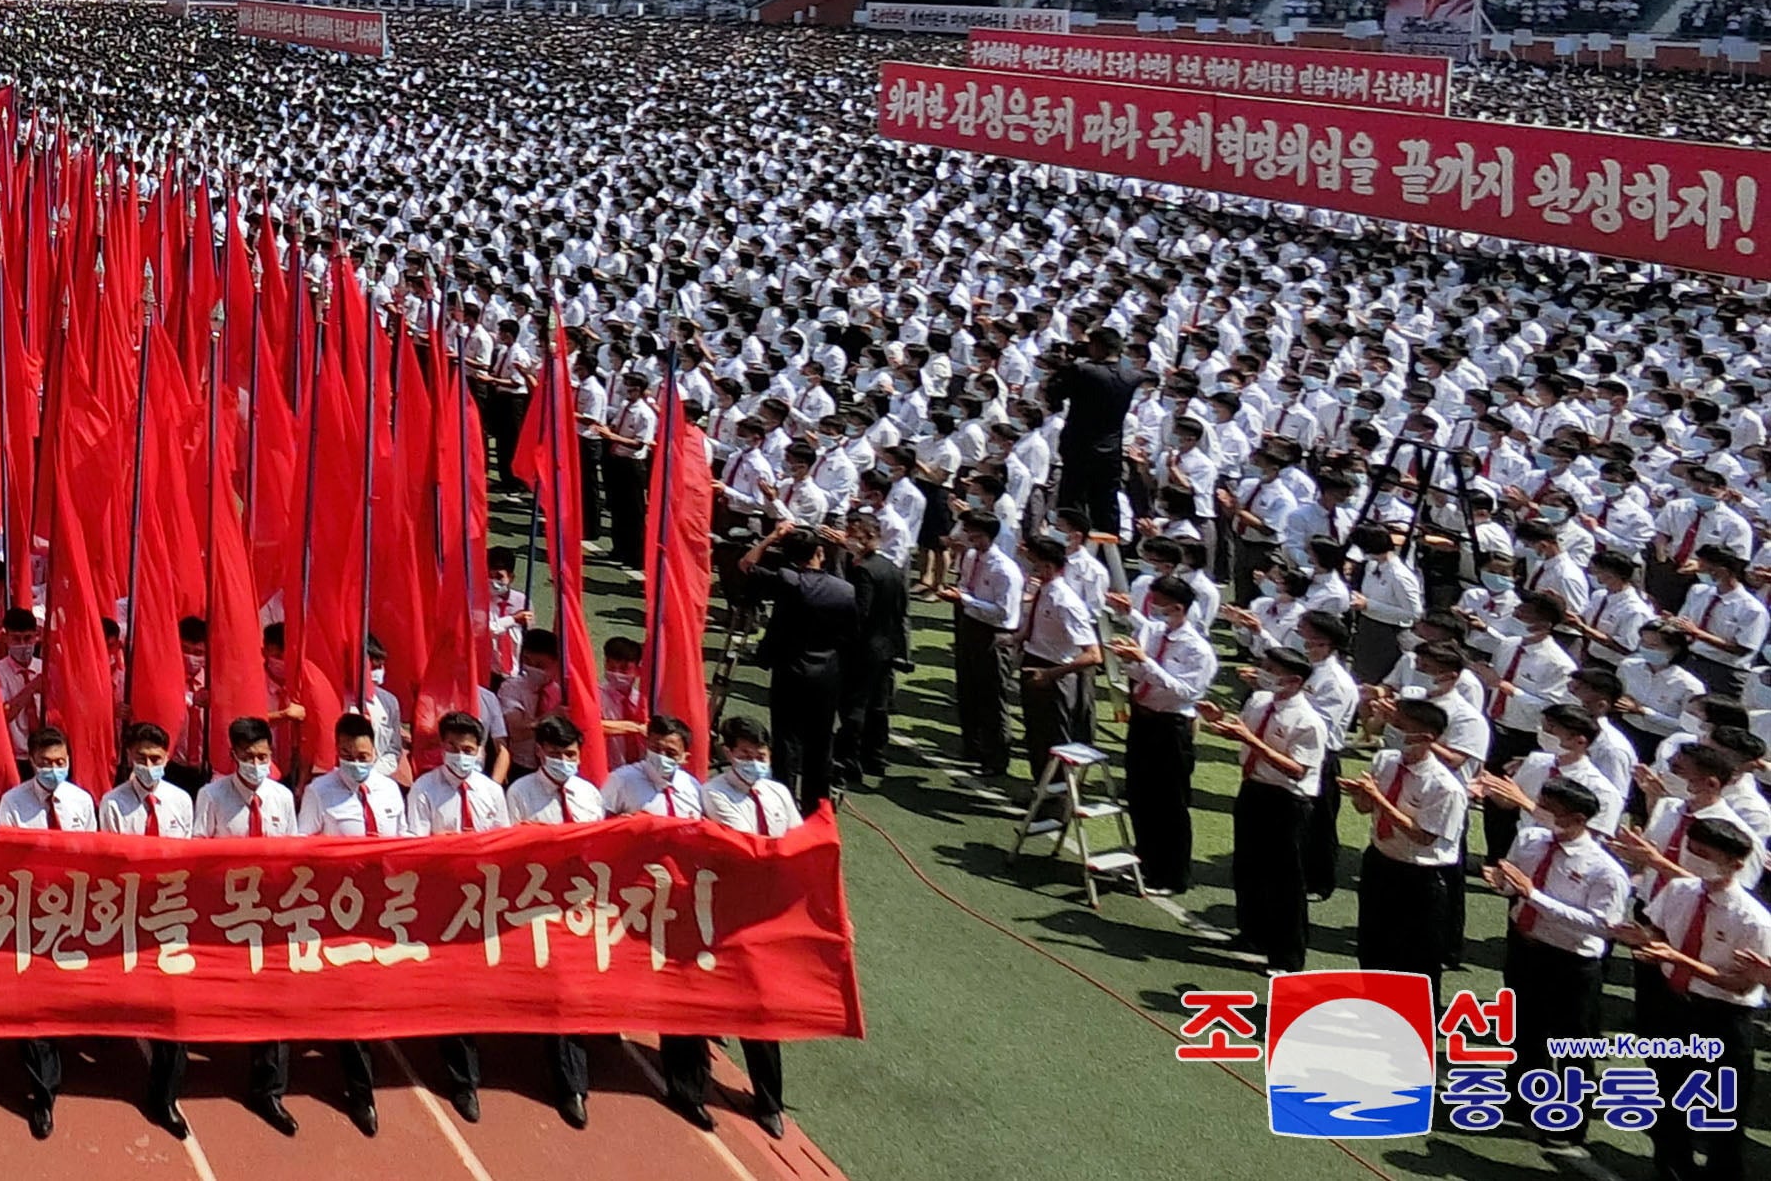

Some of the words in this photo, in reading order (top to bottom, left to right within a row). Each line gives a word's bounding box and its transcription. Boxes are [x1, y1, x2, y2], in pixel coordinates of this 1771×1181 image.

[1371, 70, 1444, 108] 수호하자!
[885, 78, 947, 129] 위대한
[948, 81, 1076, 151] 김정은동지
[1083, 100, 1142, 160] 따라
[1392, 138, 1515, 217] 끝까지
[1528, 152, 1758, 255] 완성하자!
[210, 865, 430, 975] 목숨으로
[440, 861, 720, 973] 사수하자!
